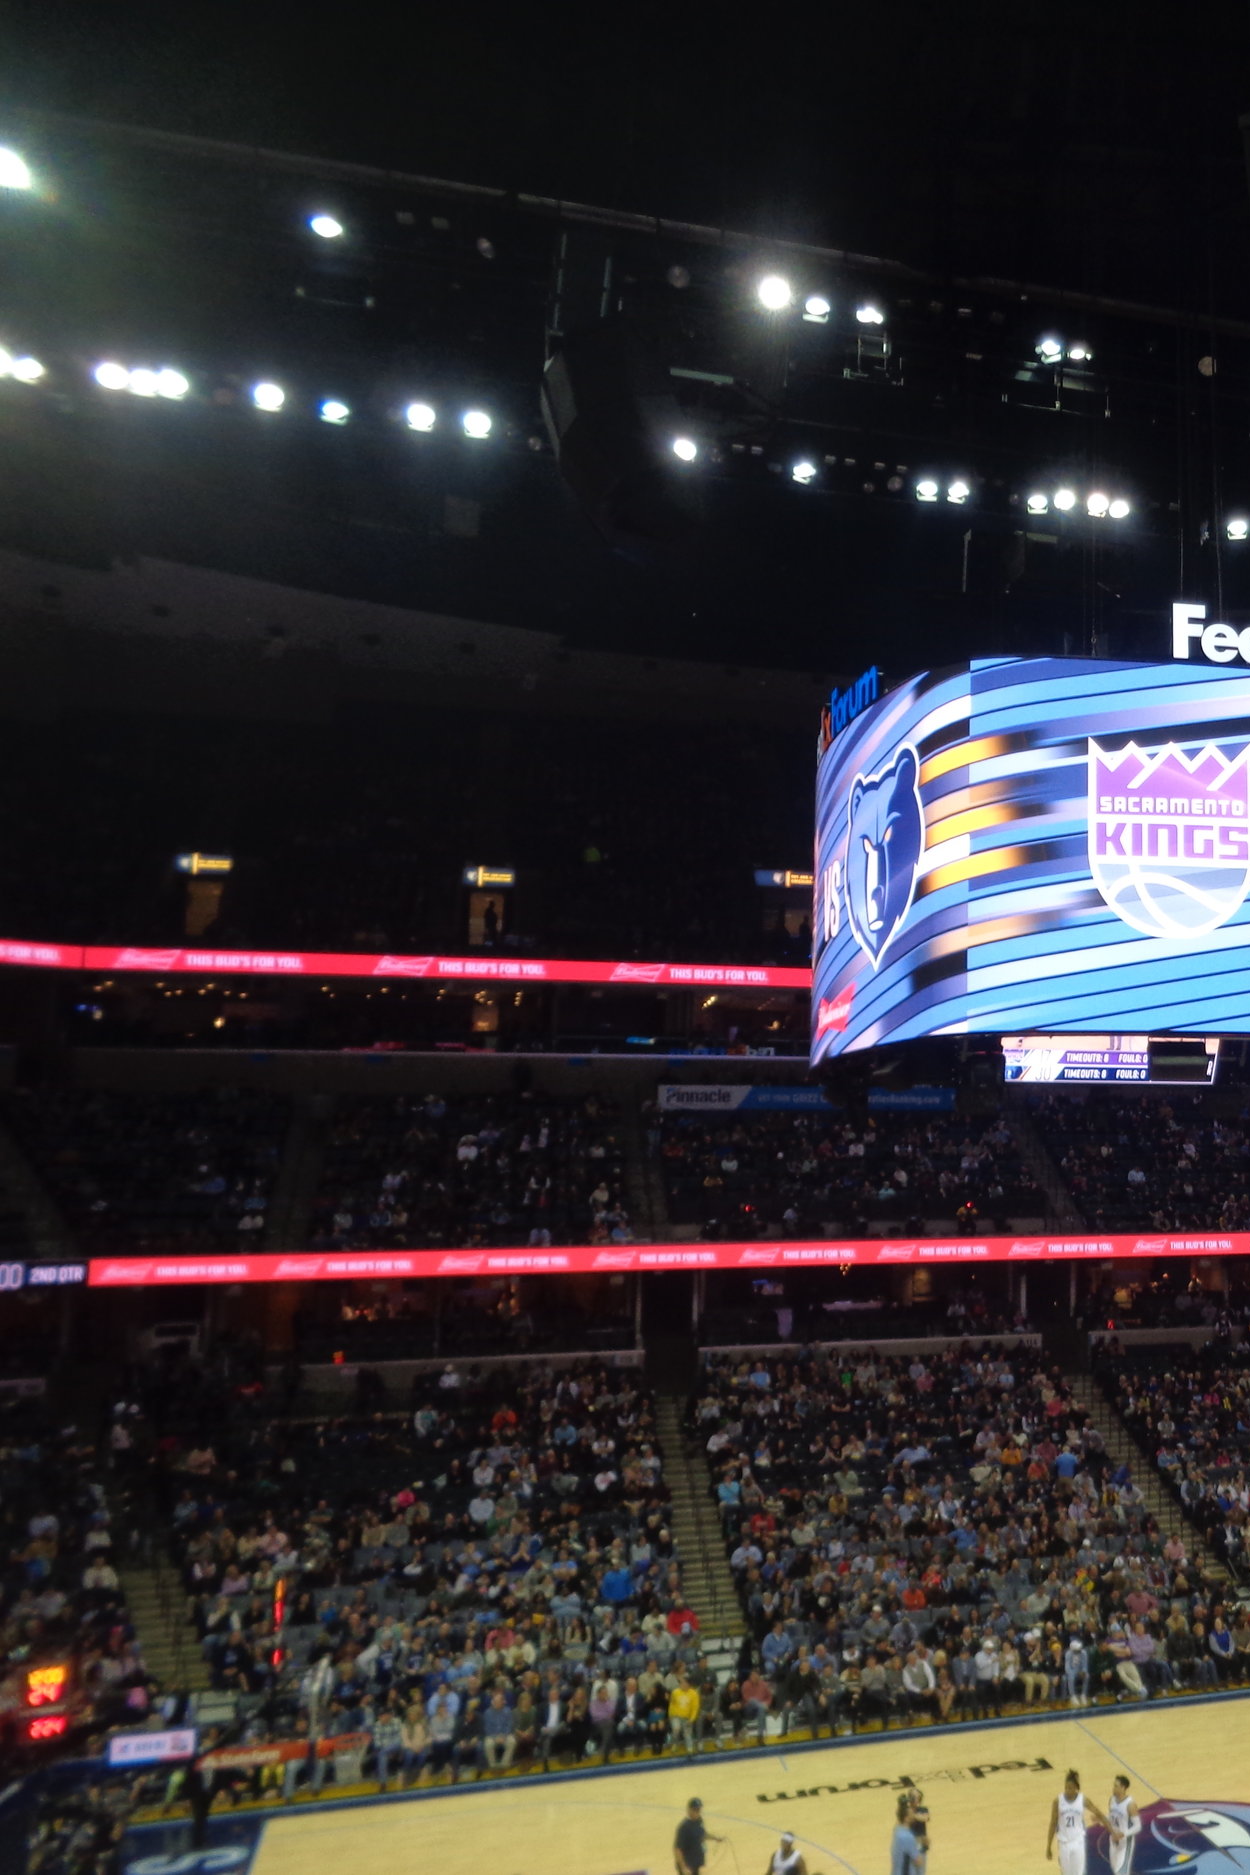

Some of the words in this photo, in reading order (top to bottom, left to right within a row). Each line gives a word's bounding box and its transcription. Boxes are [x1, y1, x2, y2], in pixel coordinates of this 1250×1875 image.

[1099, 797, 1244, 816] SACRAMENTO
[1095, 822, 1250, 861] KINGS
[824, 860, 840, 942] VS
[670, 968, 692, 979] THIS
[693, 969, 723, 980] BUD'S
[725, 970, 744, 981] FOR
[1066, 1053, 1103, 1063] TIMEOUTS:
[1118, 1053, 1142, 1064] FOULS:
[1064, 1069, 1100, 1079] TIMEOUTS:
[1116, 1069, 1139, 1079] FOULS:
[1140, 1069, 1146, 1079] 0
[1066, 1816, 1075, 1828] 21
